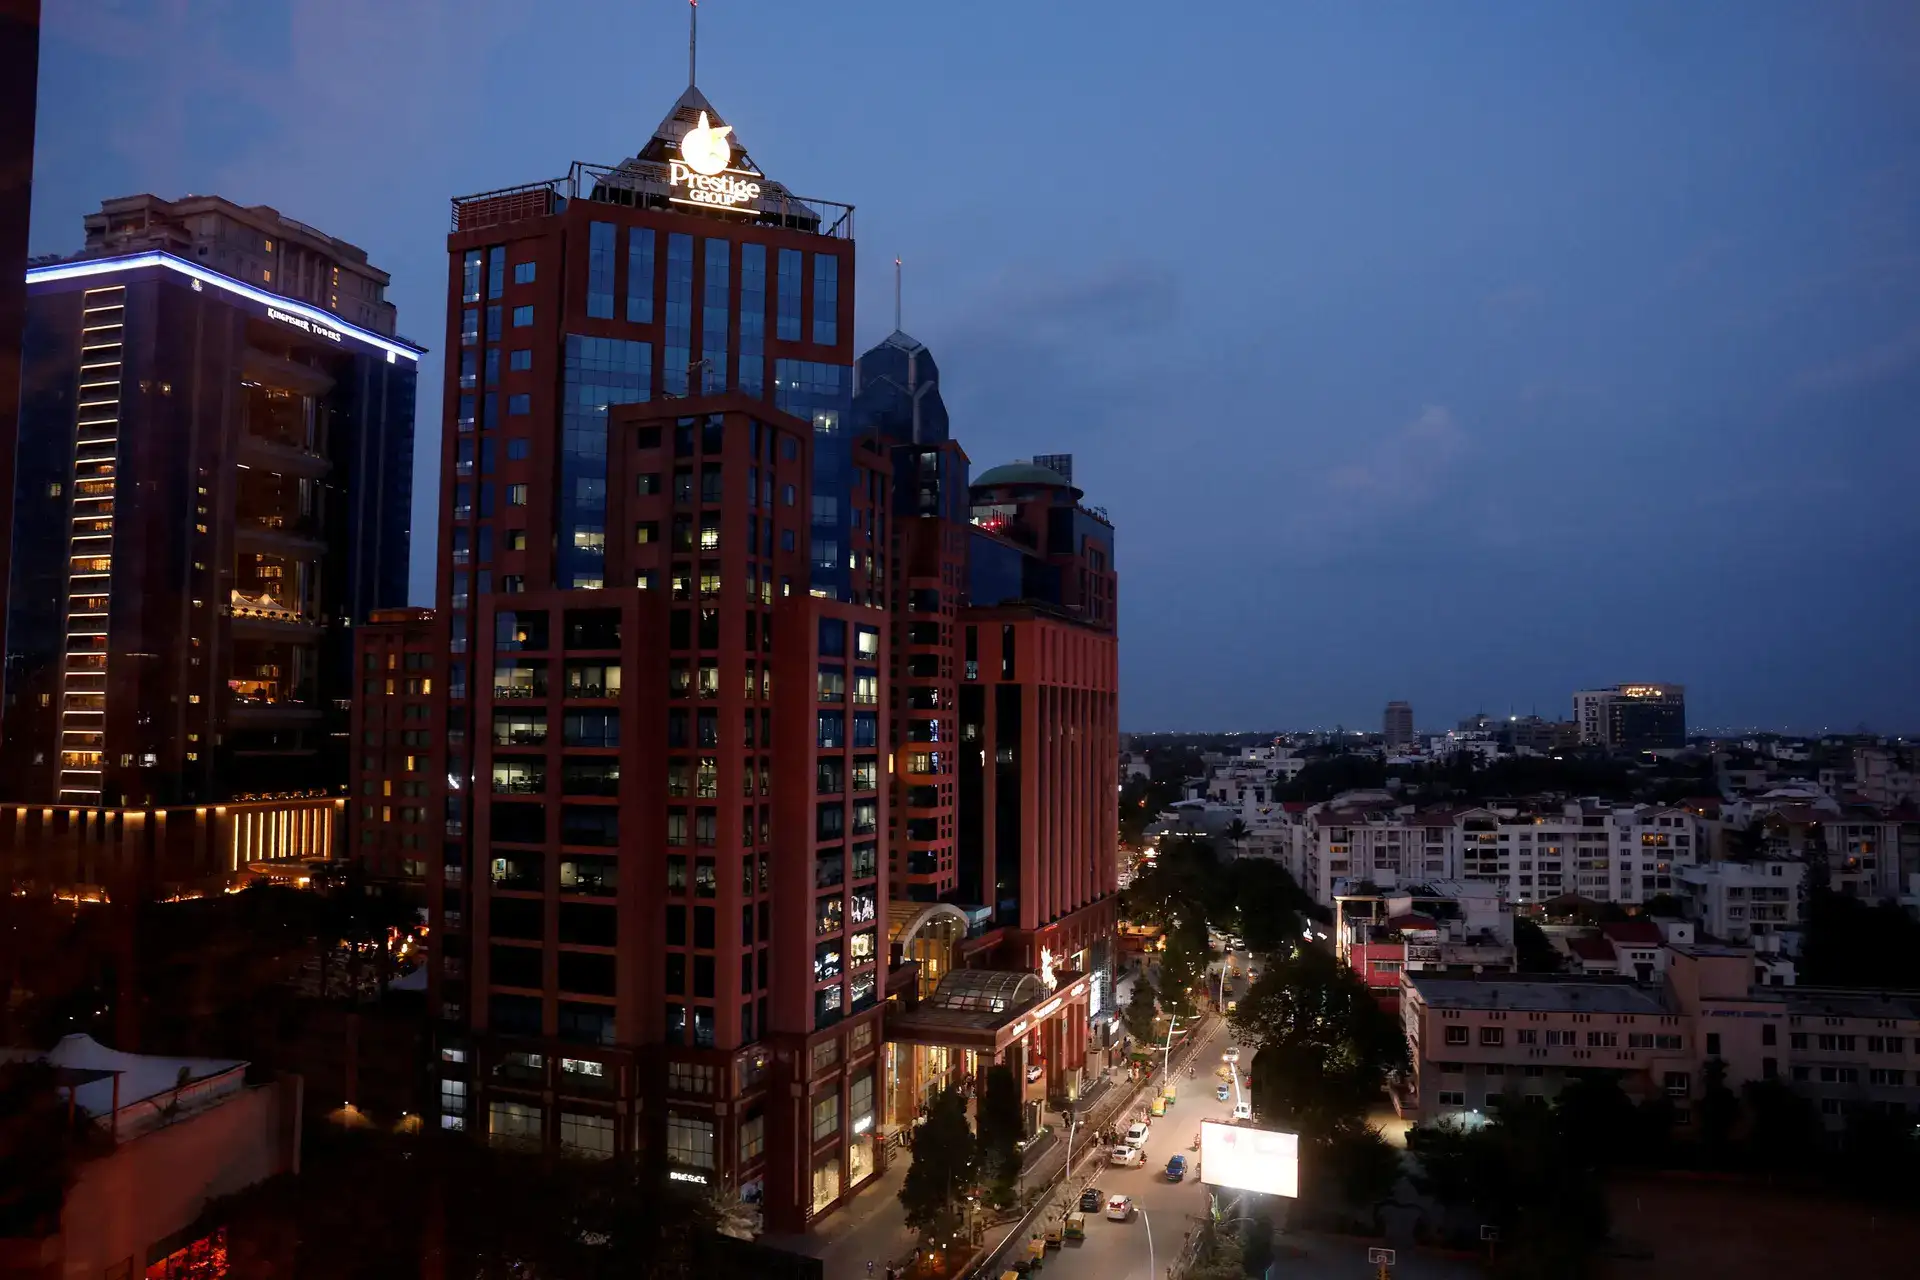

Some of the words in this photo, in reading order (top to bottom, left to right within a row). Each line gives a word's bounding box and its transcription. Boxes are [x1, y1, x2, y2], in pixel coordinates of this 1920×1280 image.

[669, 162, 760, 202] Prestige
[689, 189, 736, 206] GROUP
[670, 1172, 707, 1184] DIESEL
